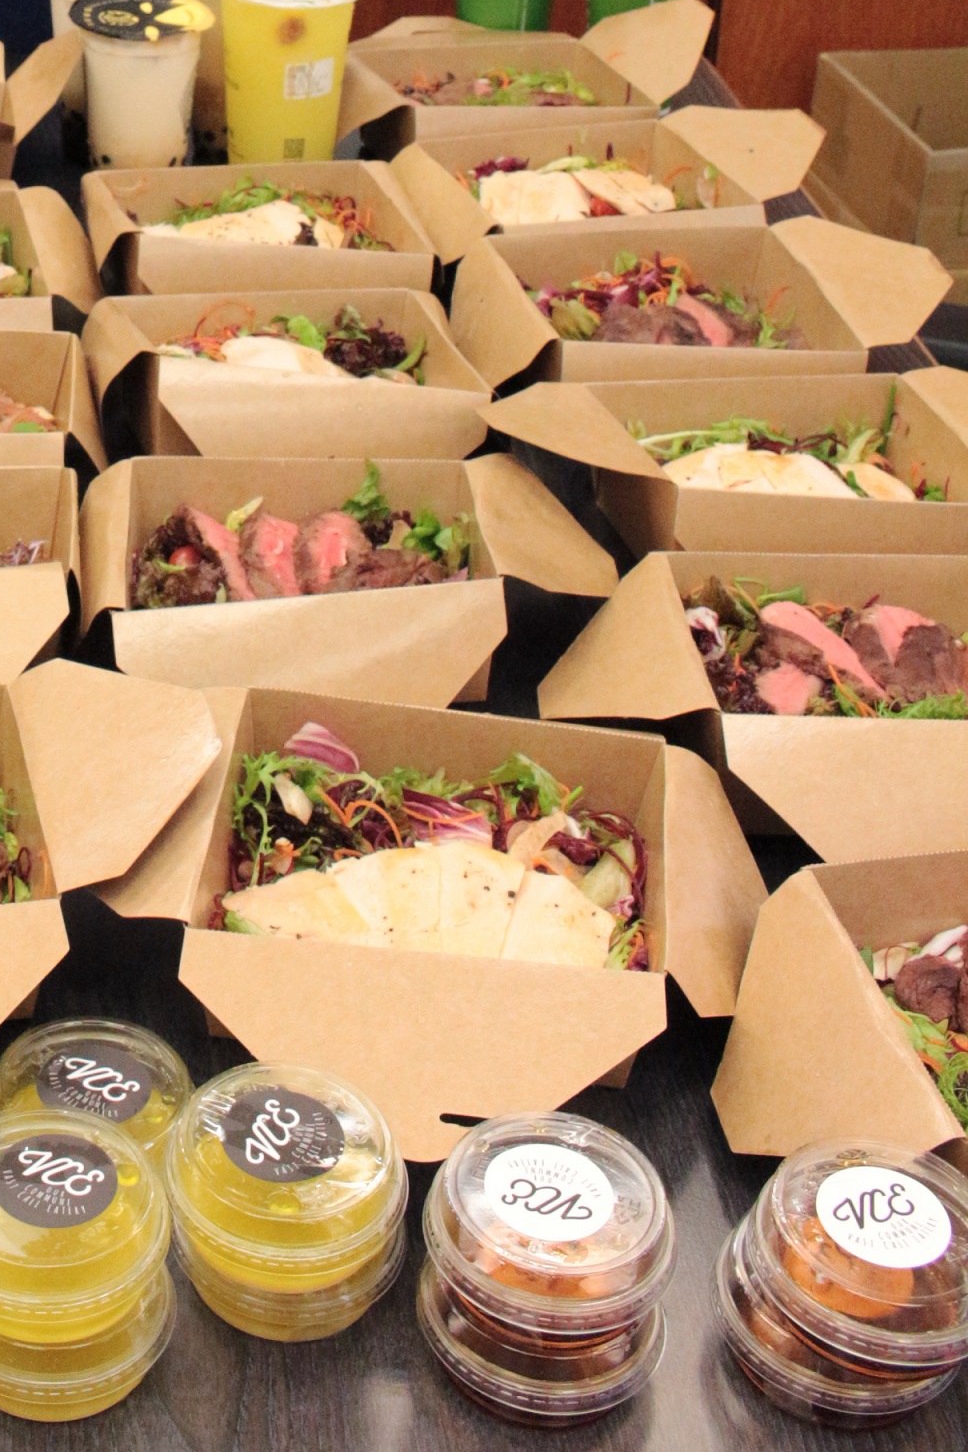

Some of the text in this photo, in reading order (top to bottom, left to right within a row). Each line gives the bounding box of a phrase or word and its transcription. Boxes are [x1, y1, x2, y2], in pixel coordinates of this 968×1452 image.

[65, 1057, 141, 1102] VCE
[245, 1099, 300, 1164] VCE
[2, 1169, 18, 1188] VAST
[18, 1149, 105, 1196] VCE
[501, 1178, 593, 1220] VCE
[832, 1183, 915, 1230] VCE
